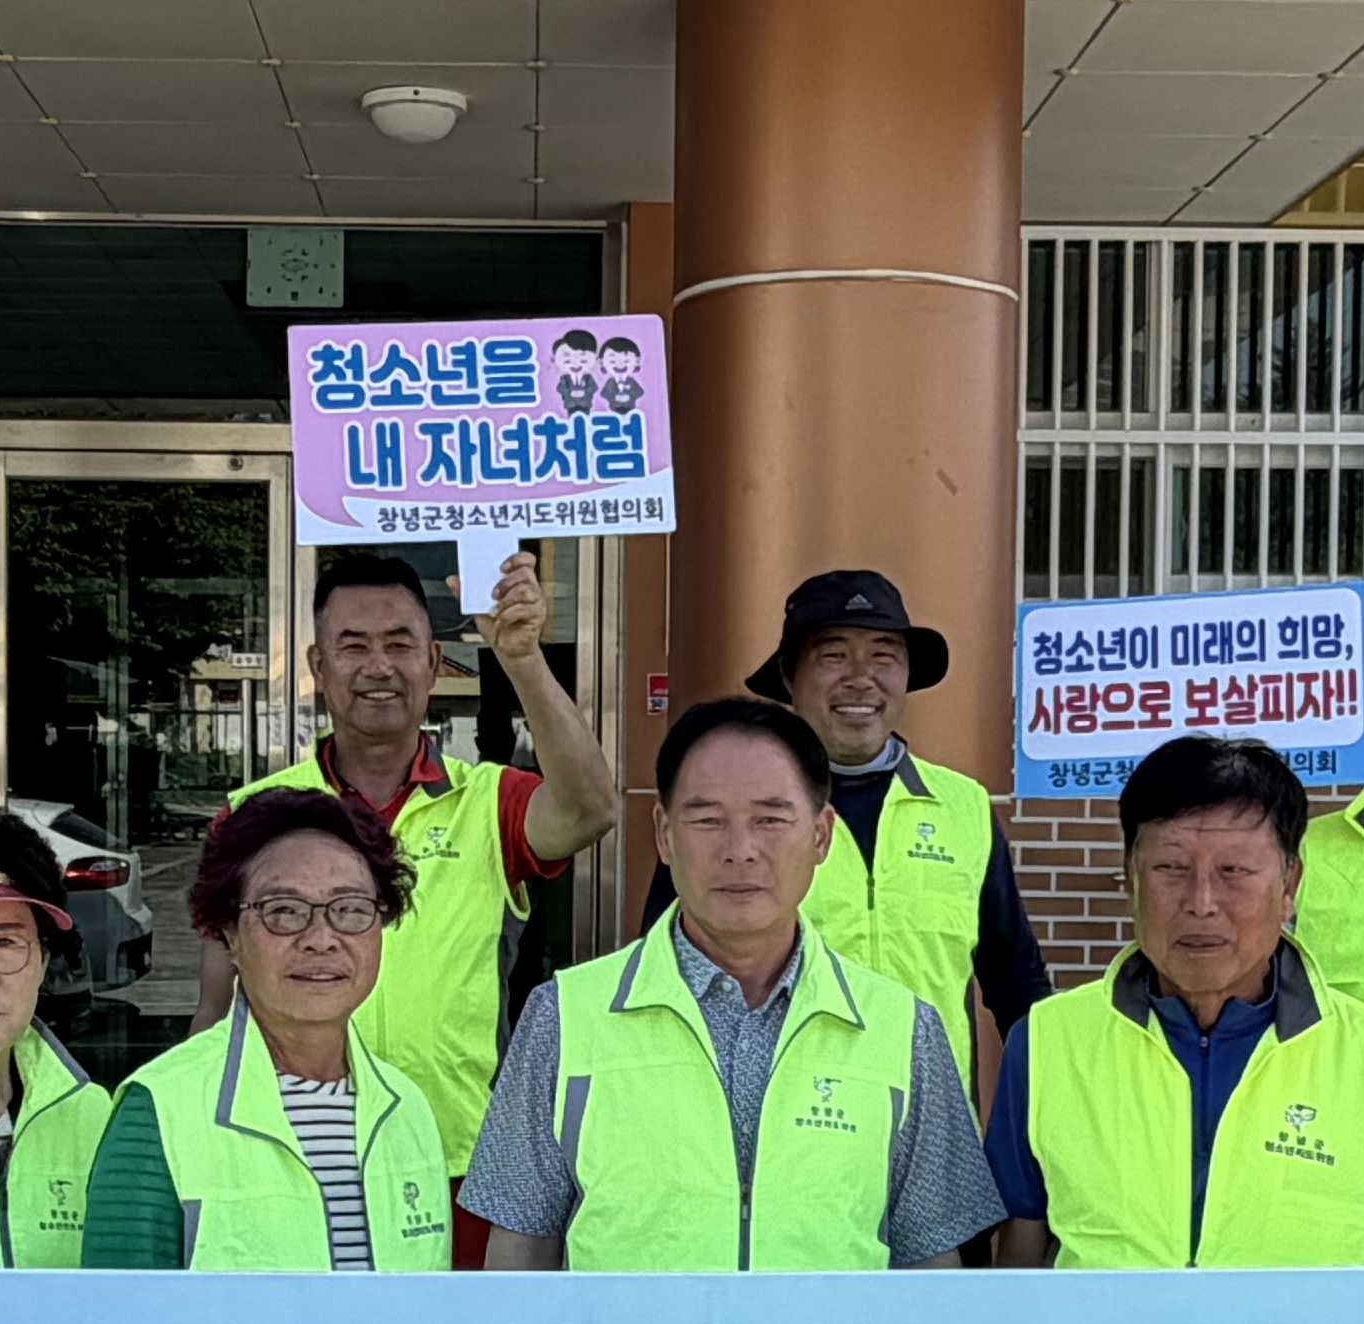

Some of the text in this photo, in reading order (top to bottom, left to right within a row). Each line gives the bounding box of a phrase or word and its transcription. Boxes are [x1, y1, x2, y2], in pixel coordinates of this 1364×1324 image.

[310, 340, 538, 411] 청소년을
[347, 415, 646, 488] 내 자녀처럼
[377, 497, 664, 533] 창녕군청소년지도위원협의회
[1033, 613, 1354, 676] 청소년이 미래의 희망,
[1028, 668, 1358, 735] 사랑으로 보살피자!!
